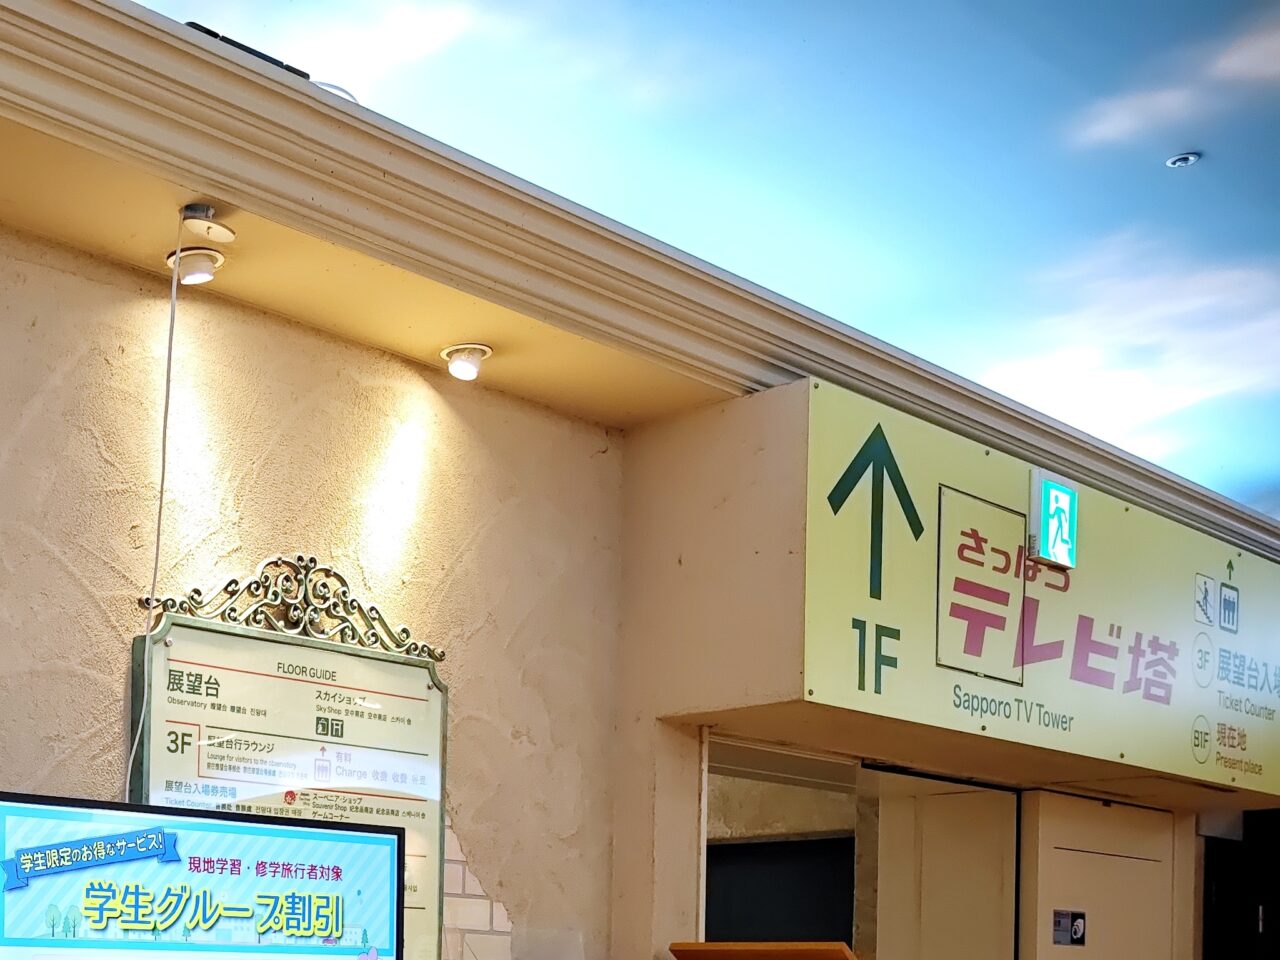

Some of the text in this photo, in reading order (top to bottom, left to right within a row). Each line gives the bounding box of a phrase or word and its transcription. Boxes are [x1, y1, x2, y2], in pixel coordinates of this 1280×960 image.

[949, 576, 1179, 706] テレビ塔
[852, 617, 901, 695] 1F
[1196, 648, 1211, 671] 3F
[167, 669, 220, 699] 展望台
[277, 662, 337, 681] FLOOR GUIDE
[167, 696, 207, 710] Observatory
[316, 705, 327, 714] Sky
[328, 706, 342, 715] Shop
[953, 684, 1075, 733] Sapporo TV Tower
[1217, 690, 1276, 721] Ticket Counter
[166, 731, 192, 754] 3F
[1193, 722, 1247, 751] B1F 現在地
[335, 765, 368, 780] Charge
[1215, 751, 1263, 776] Present place
[335, 803, 347, 812] Shop
[20, 831, 163, 873] 学生限定のお得なサービス!
[188, 856, 343, 881] 現地学習・修学旅行者対象
[84, 881, 344, 938] 学生グループ割引
